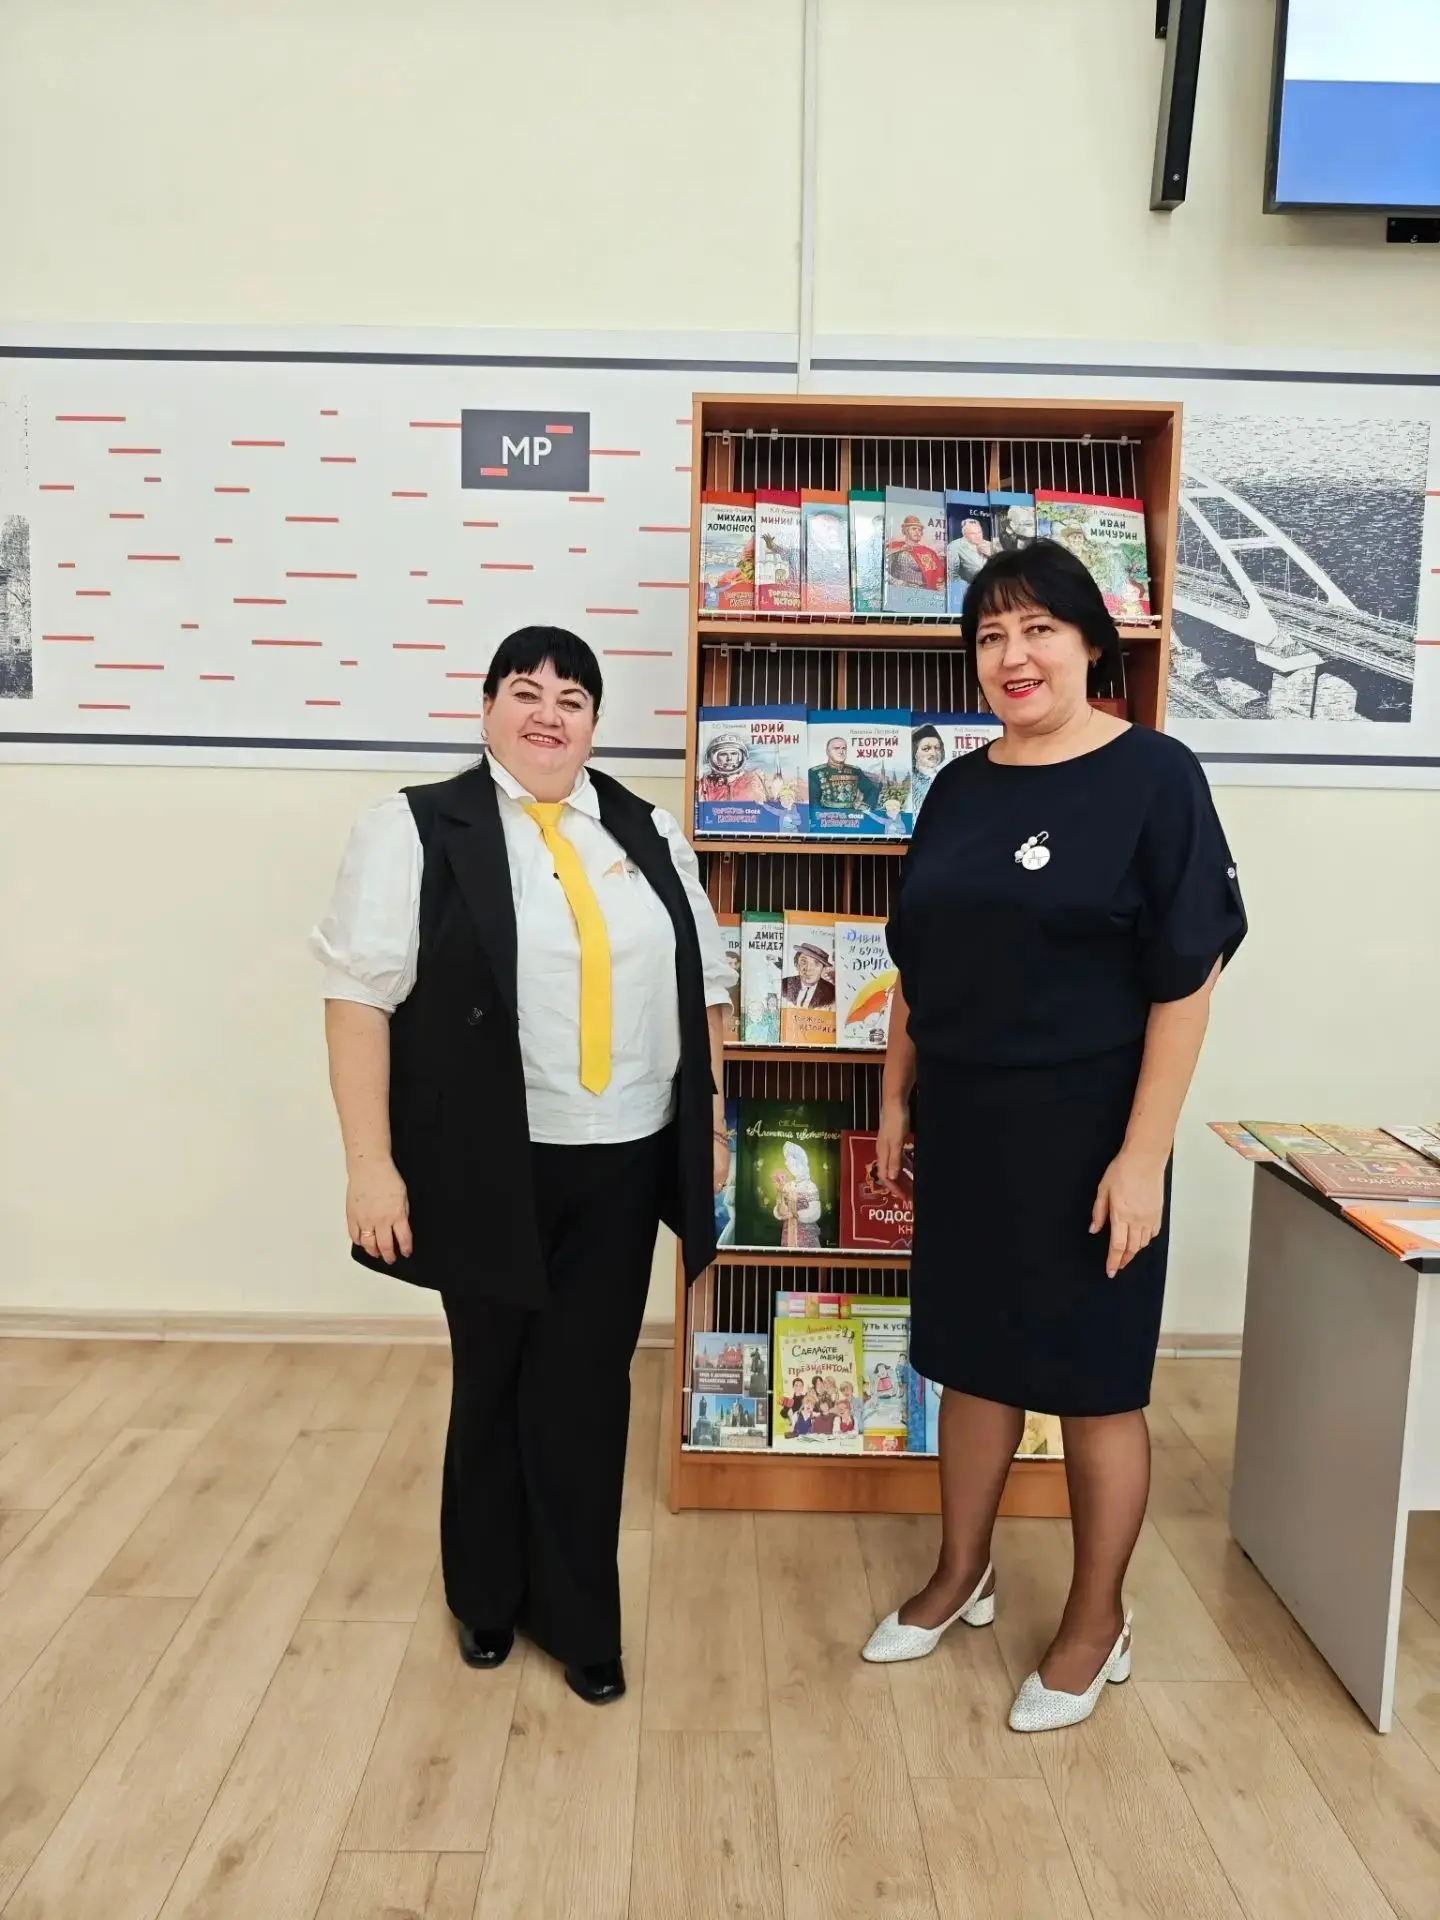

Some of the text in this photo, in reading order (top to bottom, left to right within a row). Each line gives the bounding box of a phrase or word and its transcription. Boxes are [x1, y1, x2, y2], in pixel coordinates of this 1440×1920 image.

[502, 435, 552, 465] МР
[717, 513, 753, 522] МИХАИЛ
[1100, 519, 1126, 529] ИВАН
[1090, 528, 1138, 541] МИЧУРИН
[750, 721, 784, 733] ЮРИЙ
[751, 734, 800, 745] ГАГАРИН
[851, 735, 899, 747] ГЕОРГИЙ
[954, 733, 990, 749] ПЁТР
[856, 748, 894, 758] ЖУКОВ
